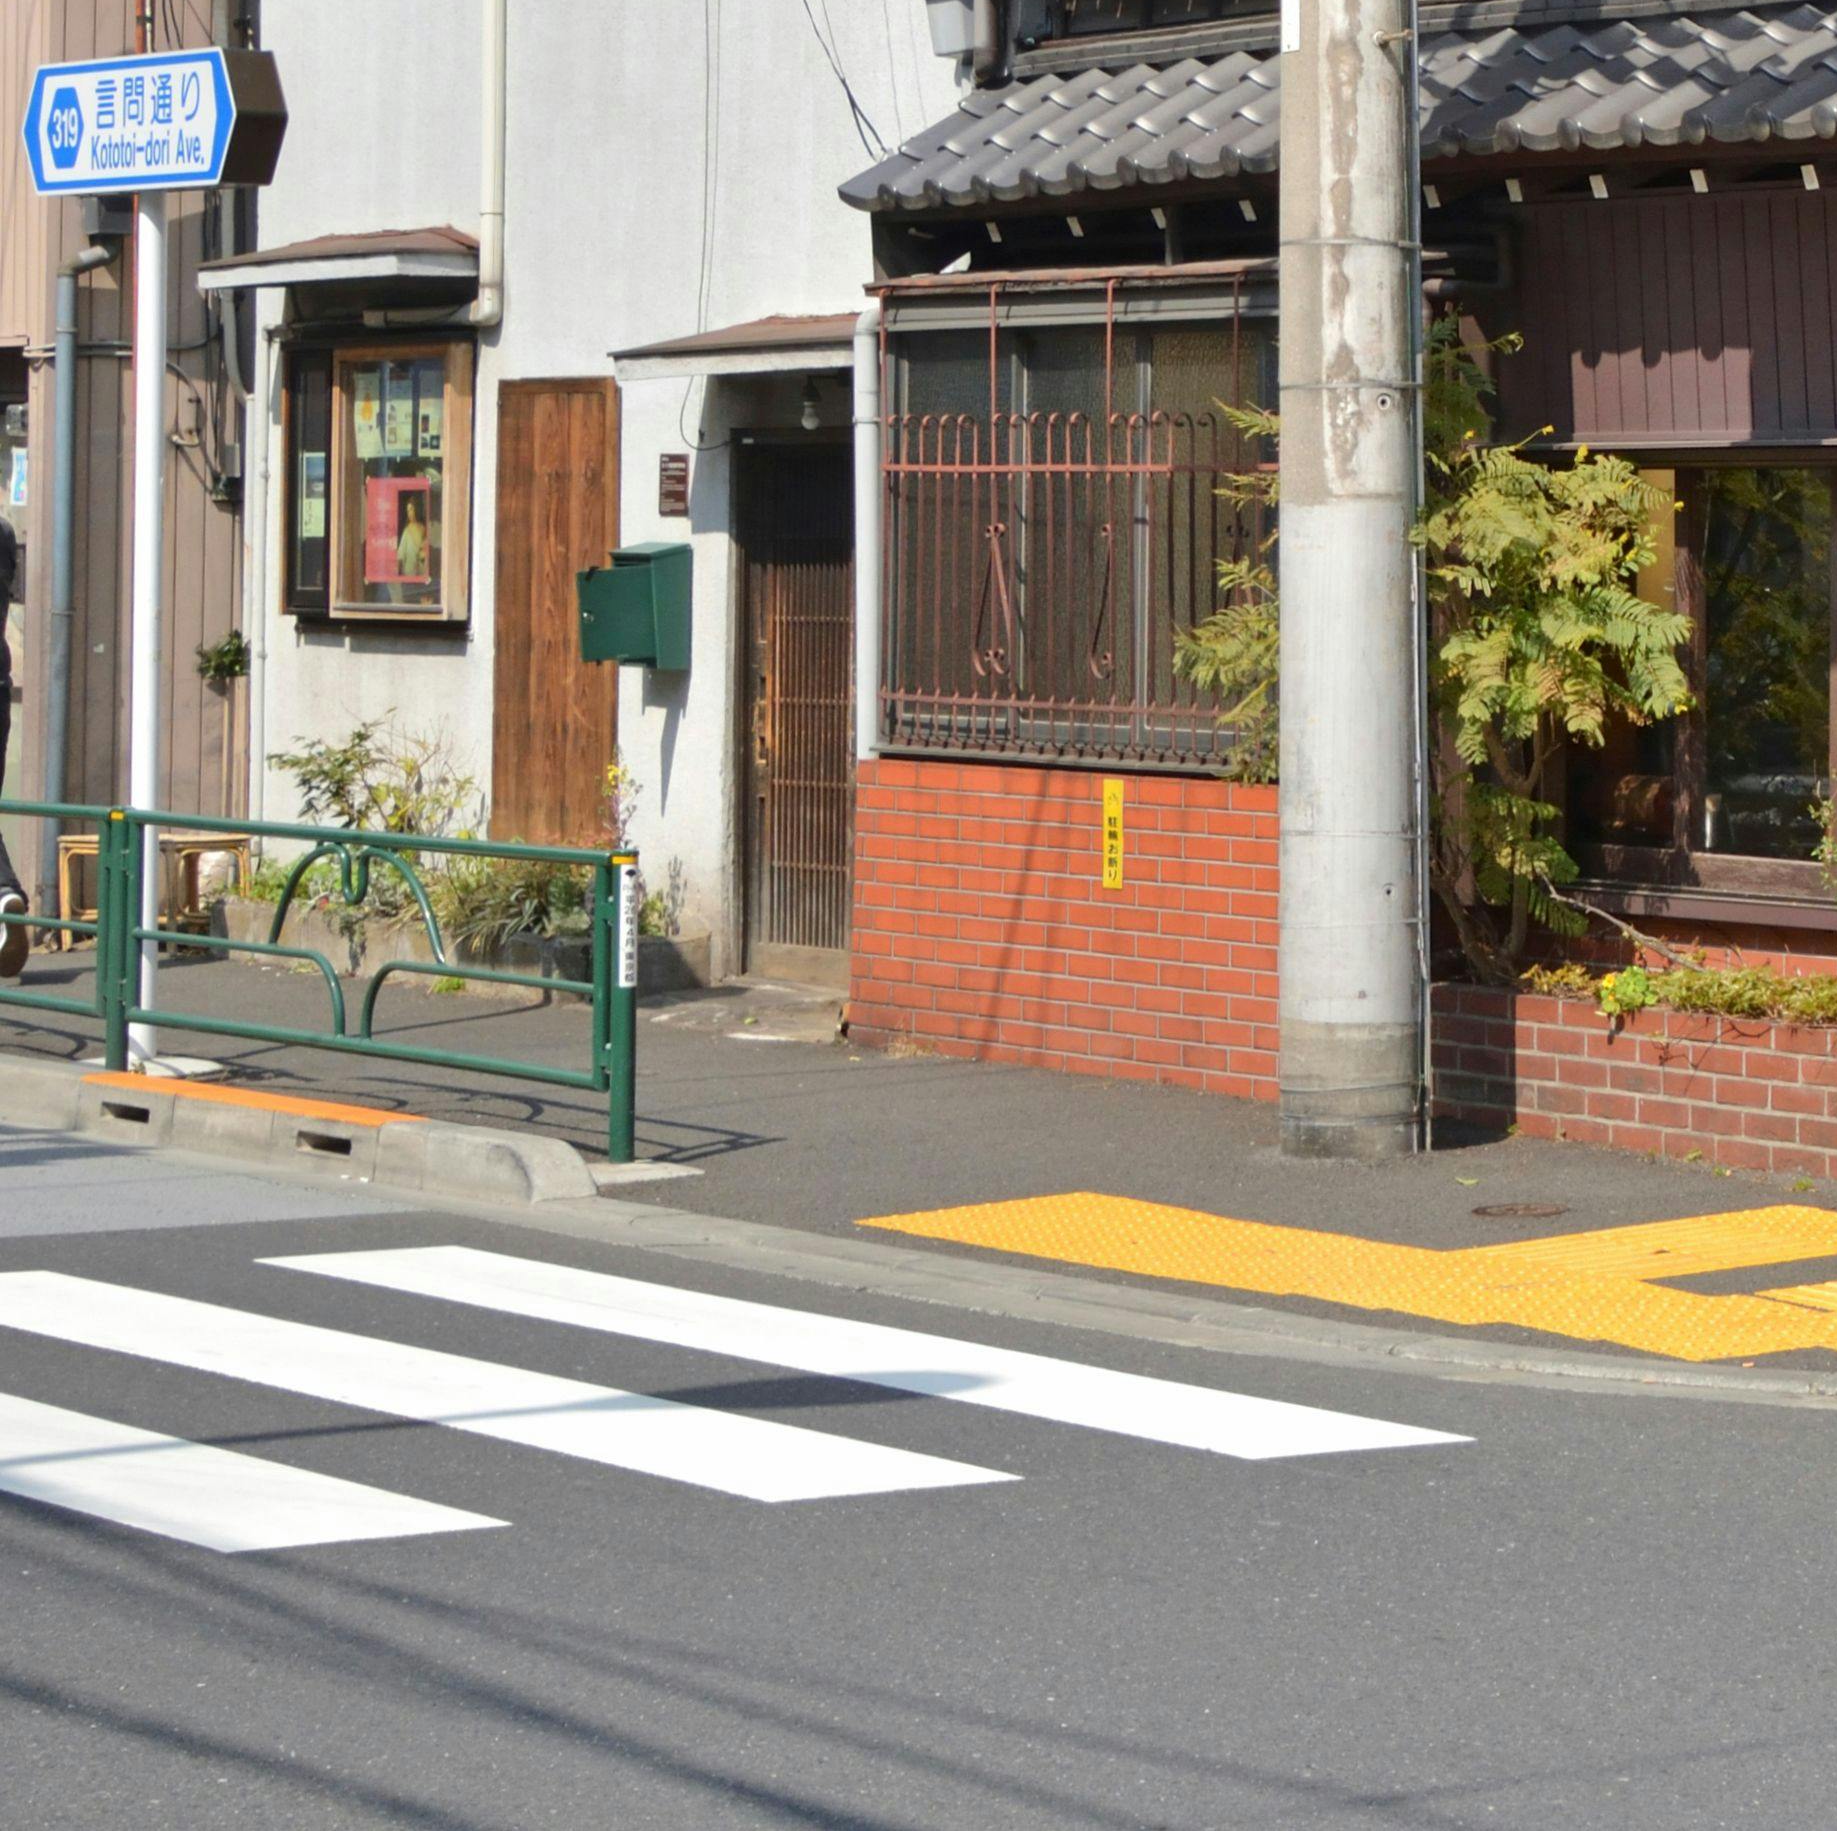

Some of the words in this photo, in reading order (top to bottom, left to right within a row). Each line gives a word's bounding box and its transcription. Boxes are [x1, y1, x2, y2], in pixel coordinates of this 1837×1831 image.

[95, 70, 202, 129] 言問通り
[53, 107, 80, 149] 319
[91, 129, 171, 171] Kototoi-dori
[175, 134, 205, 166] Ave.
